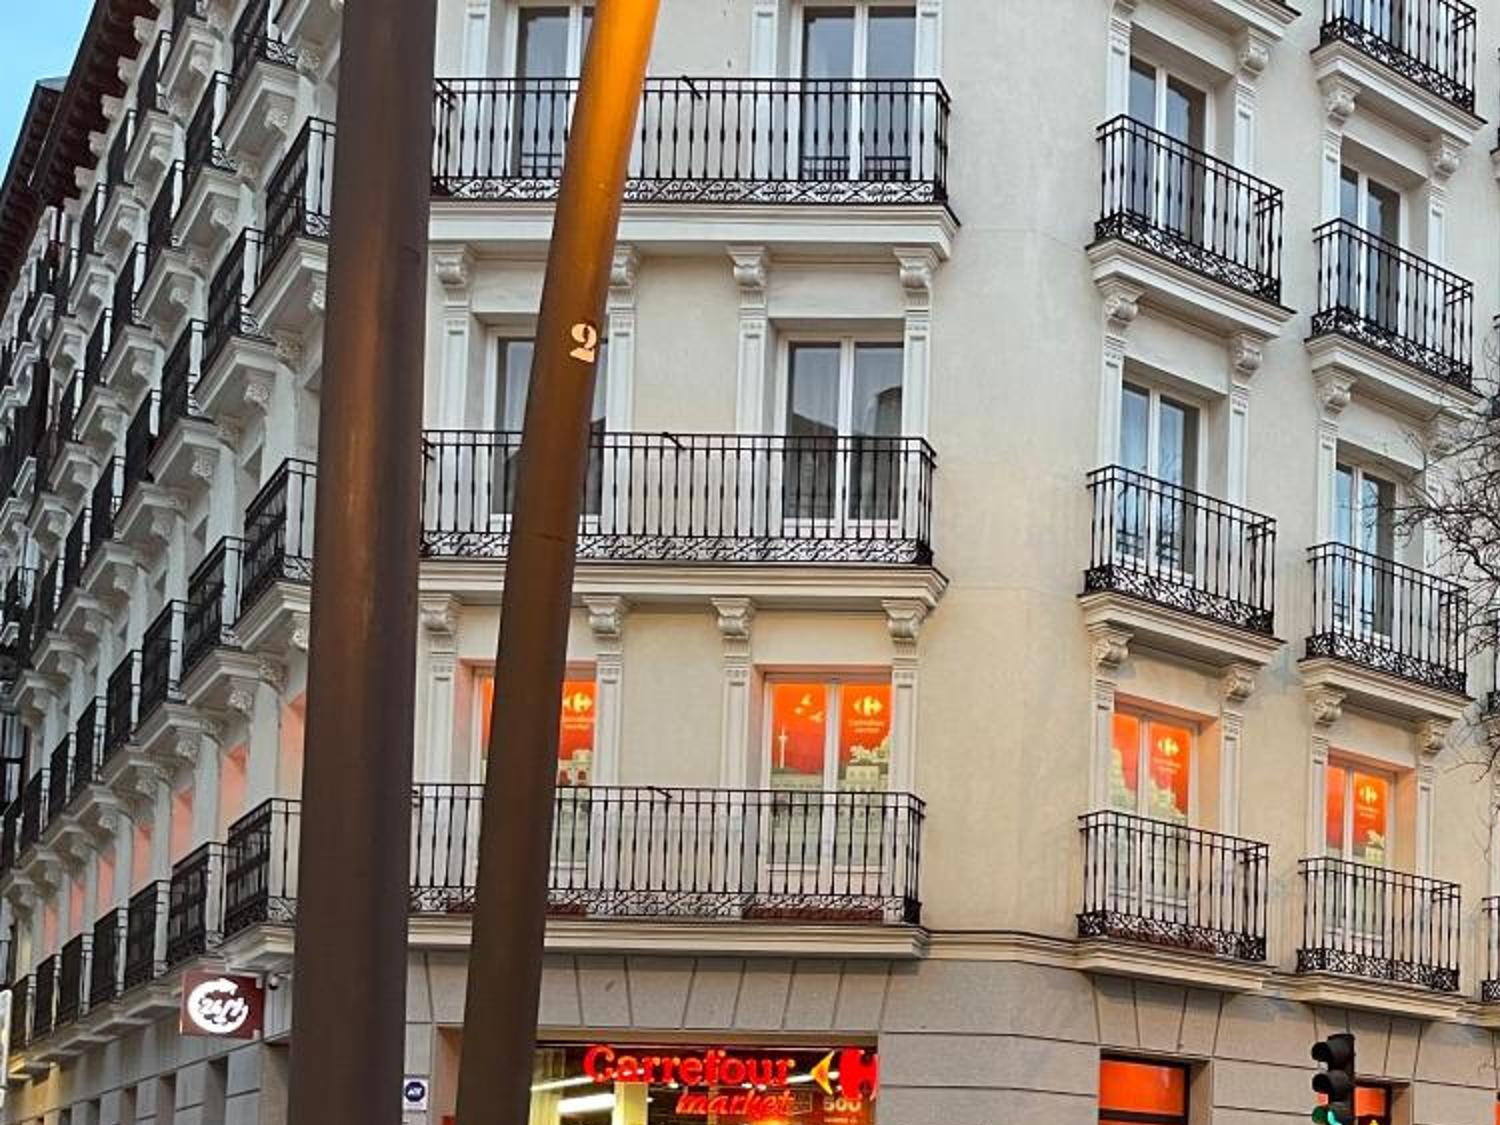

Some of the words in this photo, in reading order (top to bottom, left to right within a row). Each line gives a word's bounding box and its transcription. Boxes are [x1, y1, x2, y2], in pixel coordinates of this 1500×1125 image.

[570, 323, 597, 362] 2
[583, 1044, 796, 1085] Carrefour
[675, 1089, 796, 1115] market
